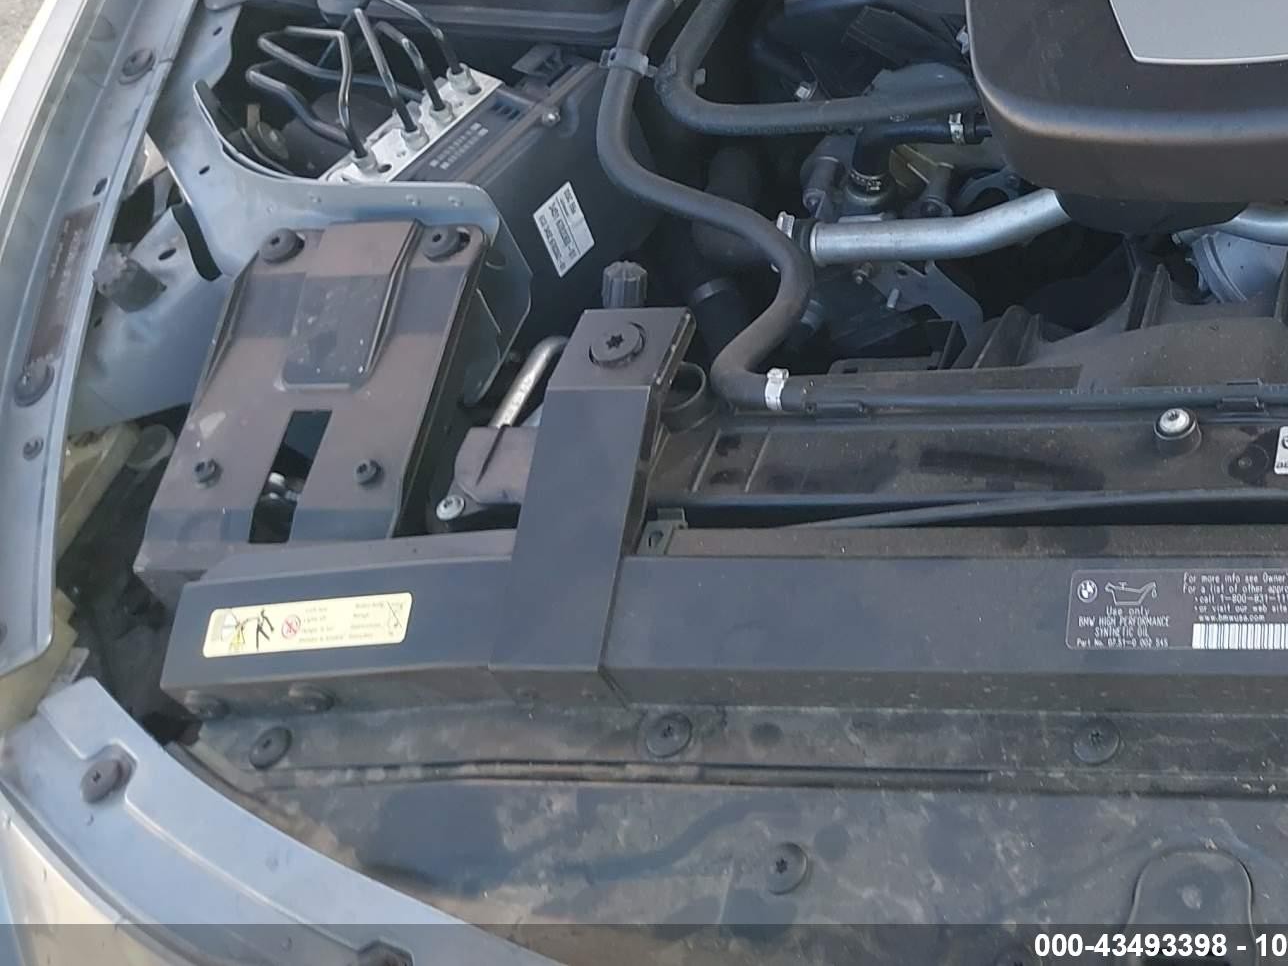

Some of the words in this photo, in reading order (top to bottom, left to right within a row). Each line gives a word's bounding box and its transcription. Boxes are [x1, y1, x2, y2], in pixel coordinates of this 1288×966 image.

[1201, 572, 1220, 583] more
[1225, 572, 1241, 583] info
[1210, 584, 1224, 594] list
[1229, 584, 1238, 594] of
[1242, 584, 1263, 594] other
[1106, 606, 1122, 616] Use
[1129, 605, 1150, 617] only
[1079, 616, 1096, 627] BMW
[1099, 616, 1116, 627] HIGH
[1120, 616, 1169, 627] PERFORMANCE
